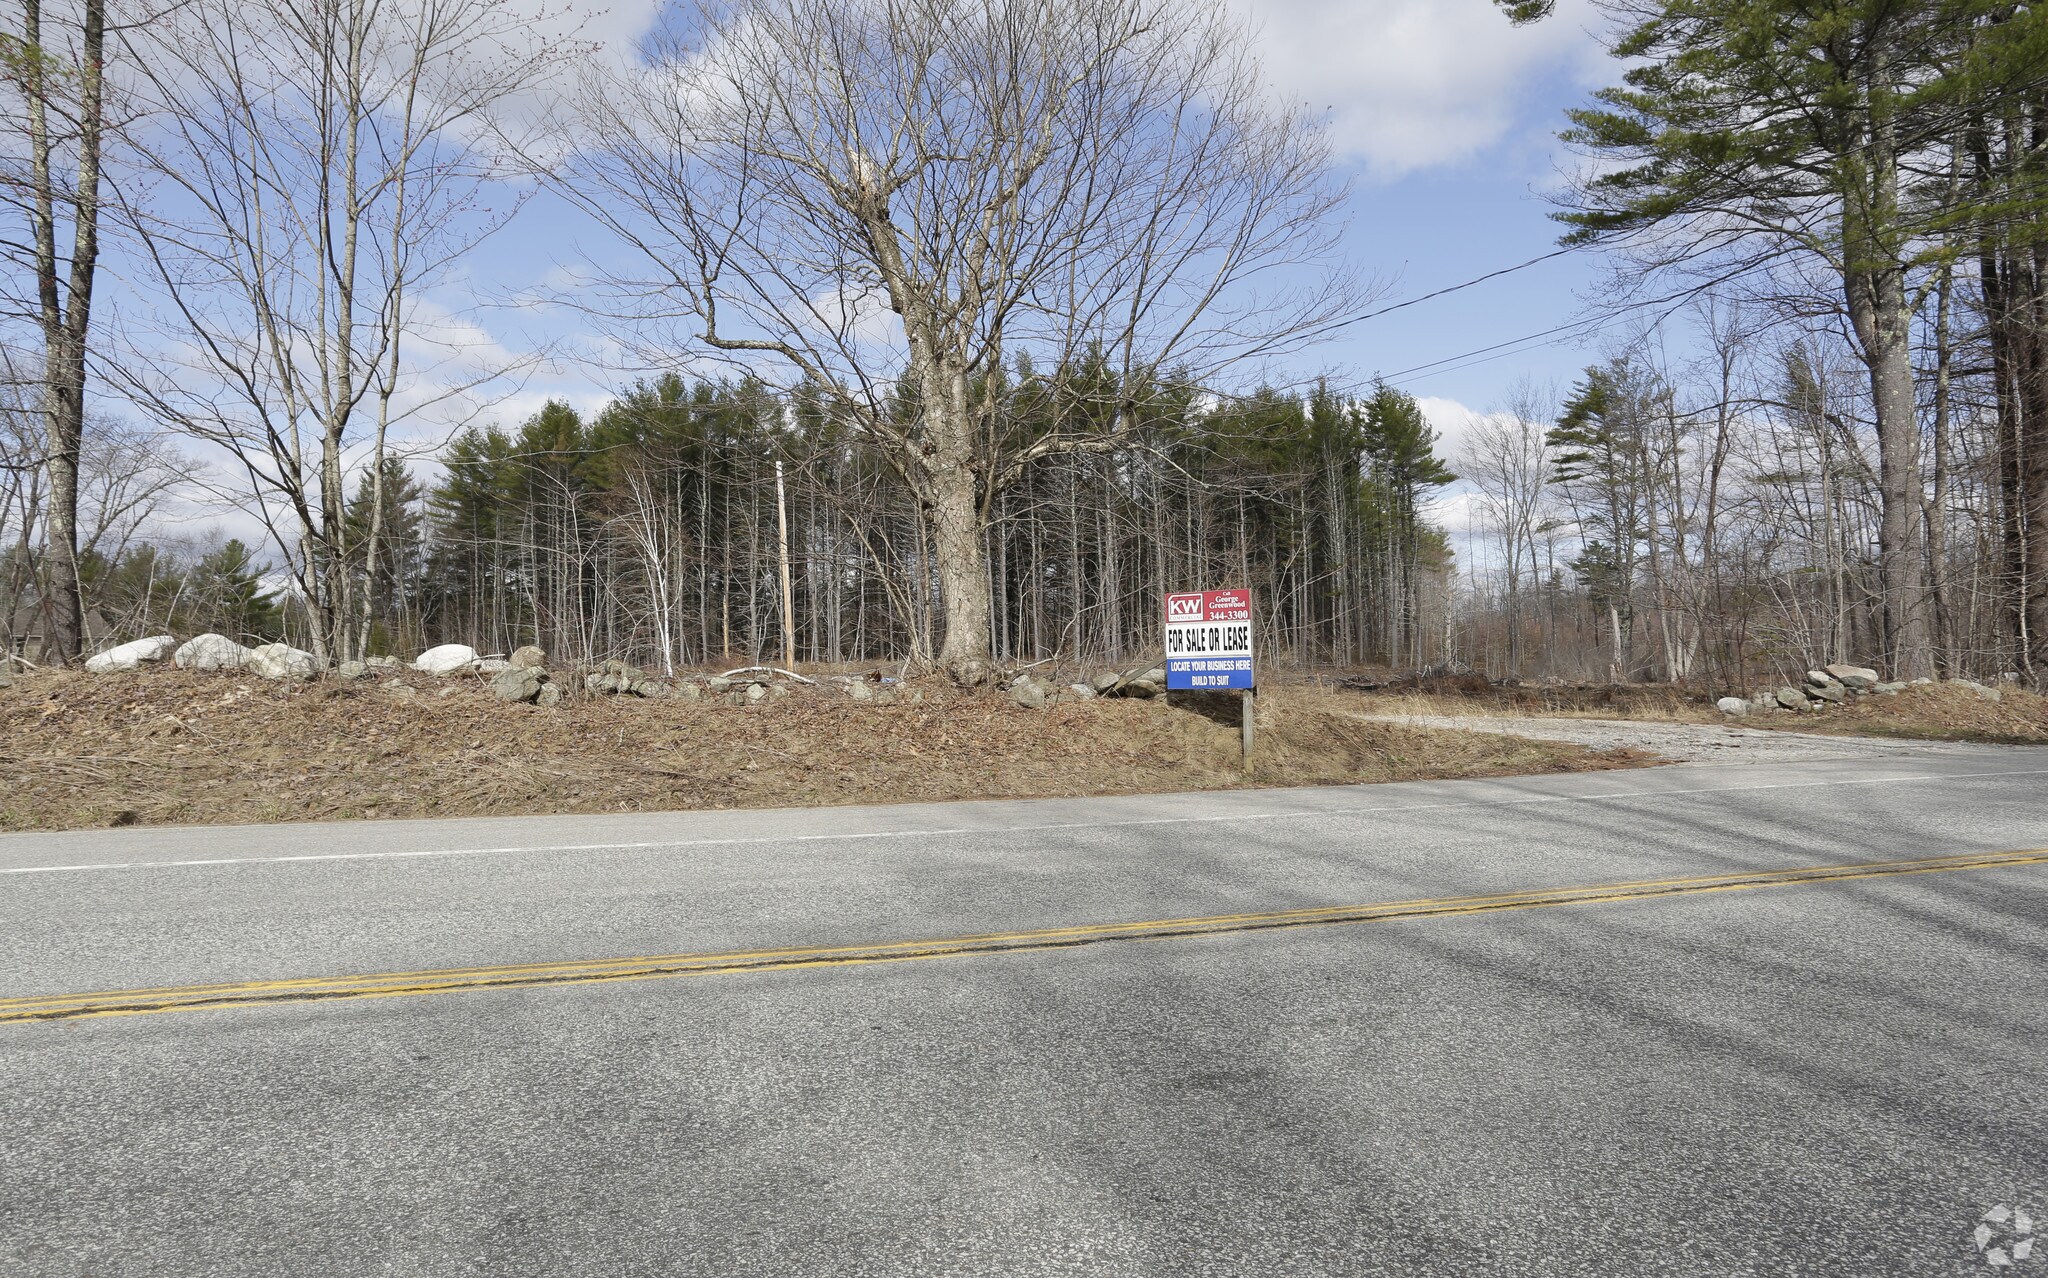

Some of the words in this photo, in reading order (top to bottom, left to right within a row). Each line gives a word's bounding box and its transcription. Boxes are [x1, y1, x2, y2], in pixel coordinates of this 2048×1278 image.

[1170, 599, 1200, 614] KW
[1210, 610, 1248, 620] 344-3300
[1169, 629, 1183, 652] FOR
[1186, 628, 1205, 652] SALE
[1209, 628, 1220, 651] OR
[1223, 626, 1248, 650] LEASE
[1171, 661, 1190, 671] LOCATE
[1191, 661, 1206, 671] YOUR
[1207, 660, 1234, 671] BUSINESS
[1235, 660, 1251, 670] HERE
[1192, 676, 1207, 686] BUILD
[1208, 676, 1215, 685] TO
[1217, 676, 1229, 685] SUIT
